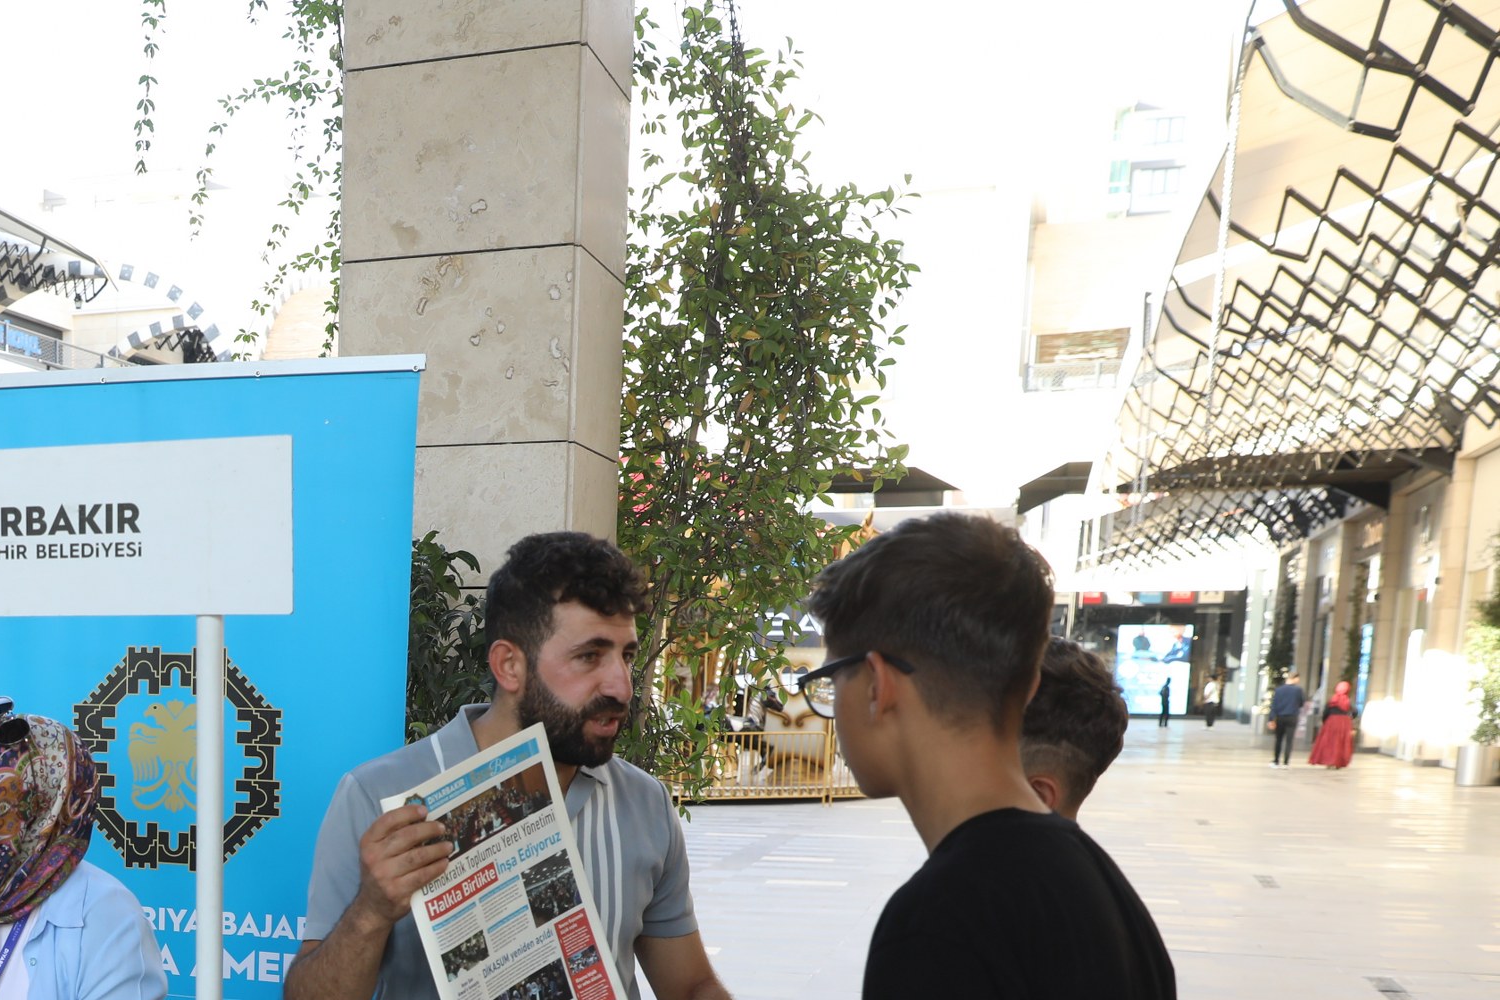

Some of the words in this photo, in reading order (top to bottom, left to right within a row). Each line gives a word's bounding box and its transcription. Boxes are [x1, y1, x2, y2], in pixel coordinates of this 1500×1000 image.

[421, 862, 466, 897] Demokratik
[465, 844, 503, 870] Toplumcu
[501, 830, 522, 850] Yerel
[521, 808, 557, 838] Yönetimi
[427, 887, 463, 918] Halkla
[461, 866, 497, 896] Birlikte
[517, 831, 563, 863] Ediyoruz
